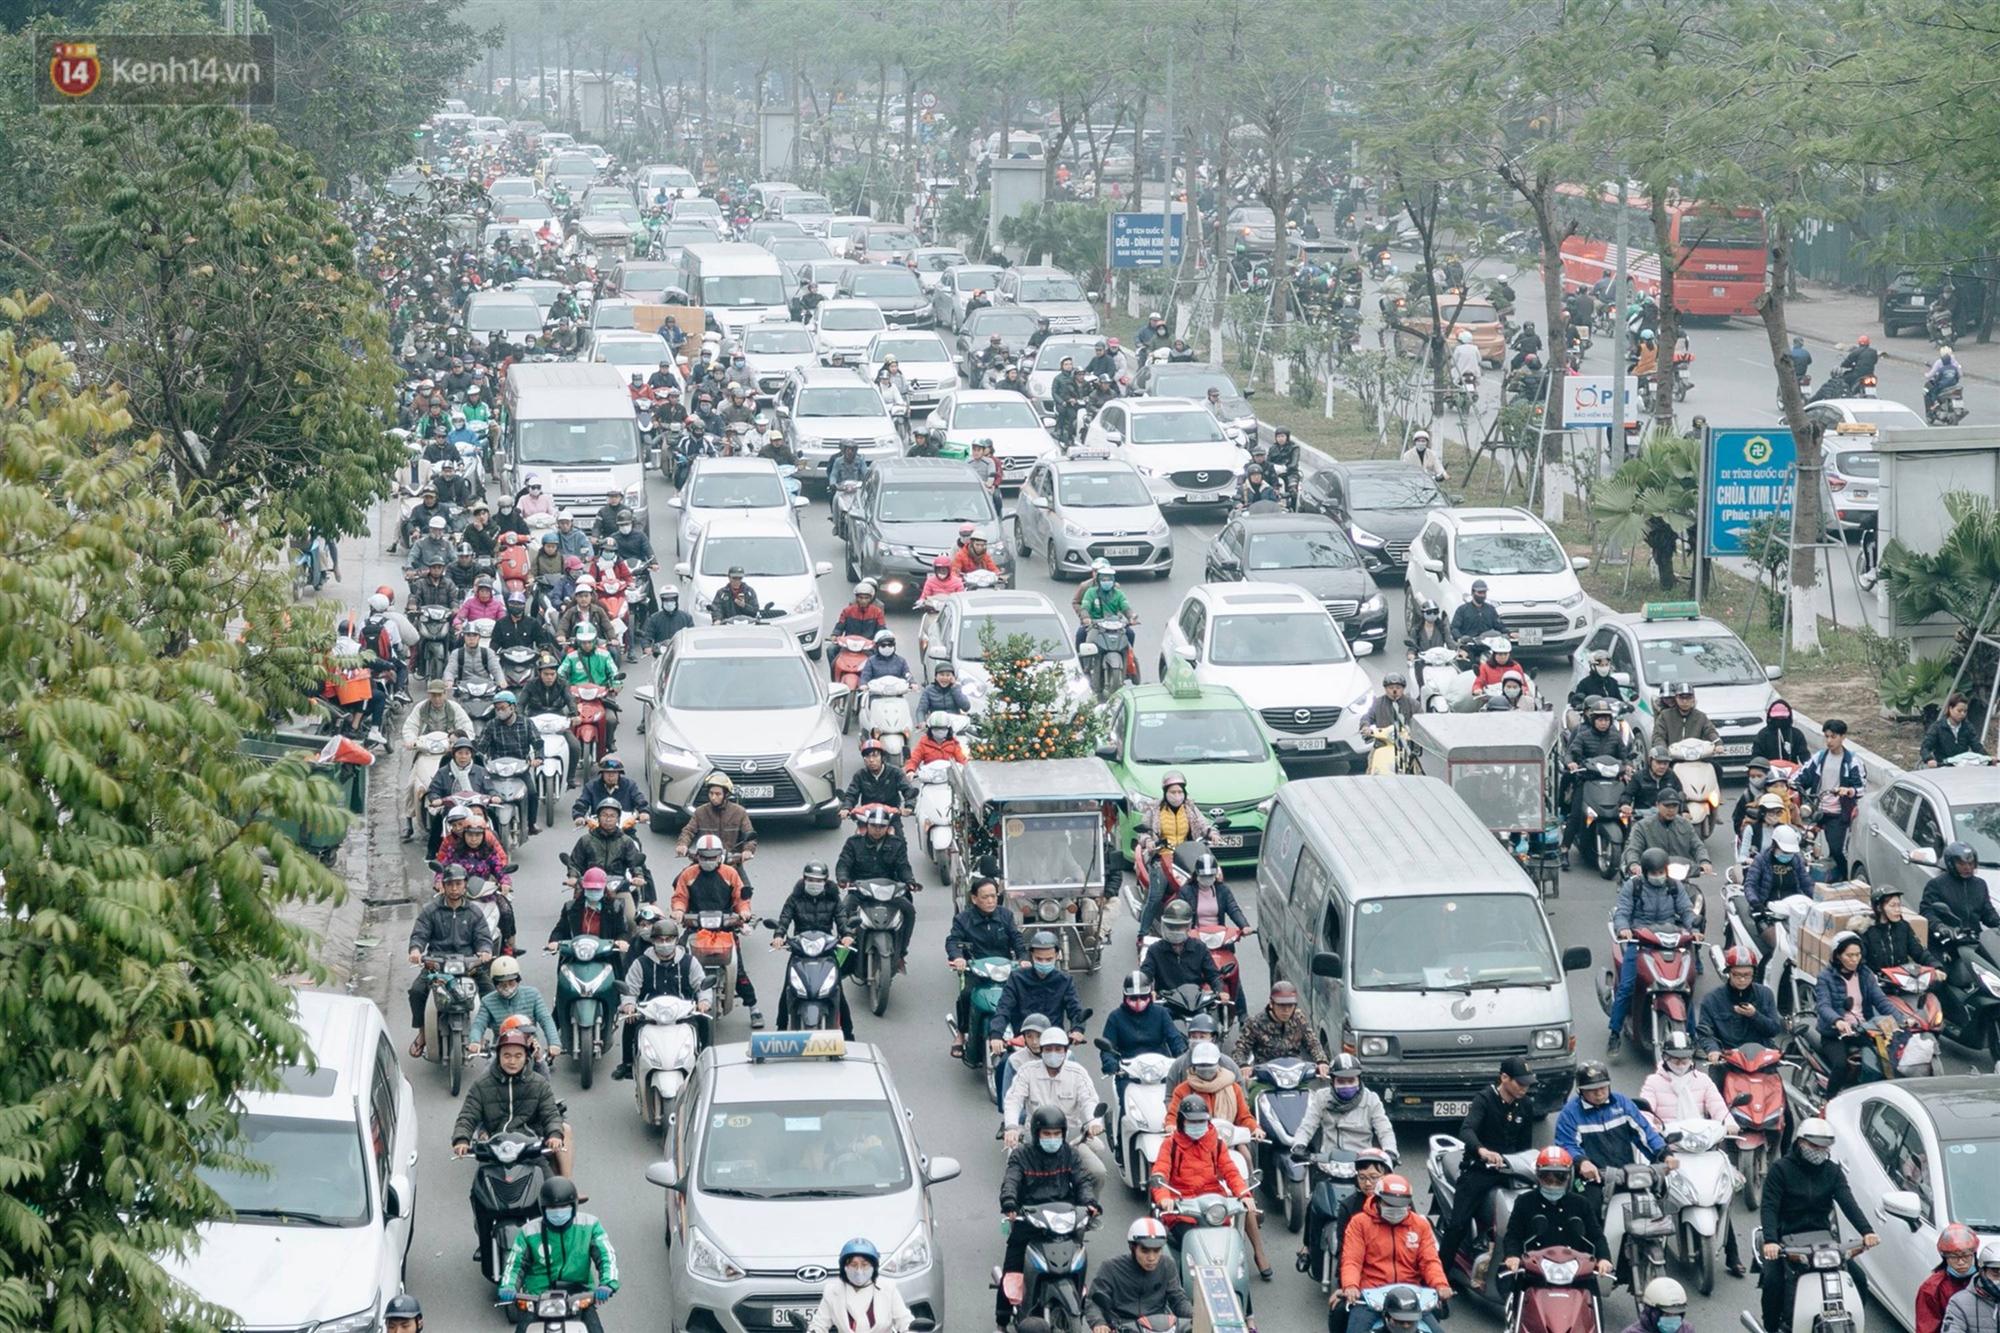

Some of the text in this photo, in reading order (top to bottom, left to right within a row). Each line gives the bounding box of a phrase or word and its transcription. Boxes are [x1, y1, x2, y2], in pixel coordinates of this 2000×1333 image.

[1600, 390, 1629, 405] PI
[1717, 481, 1746, 505] CHÙA
[1748, 486, 1770, 505] KIM
[1435, 1102, 1469, 1116] 29B-0
